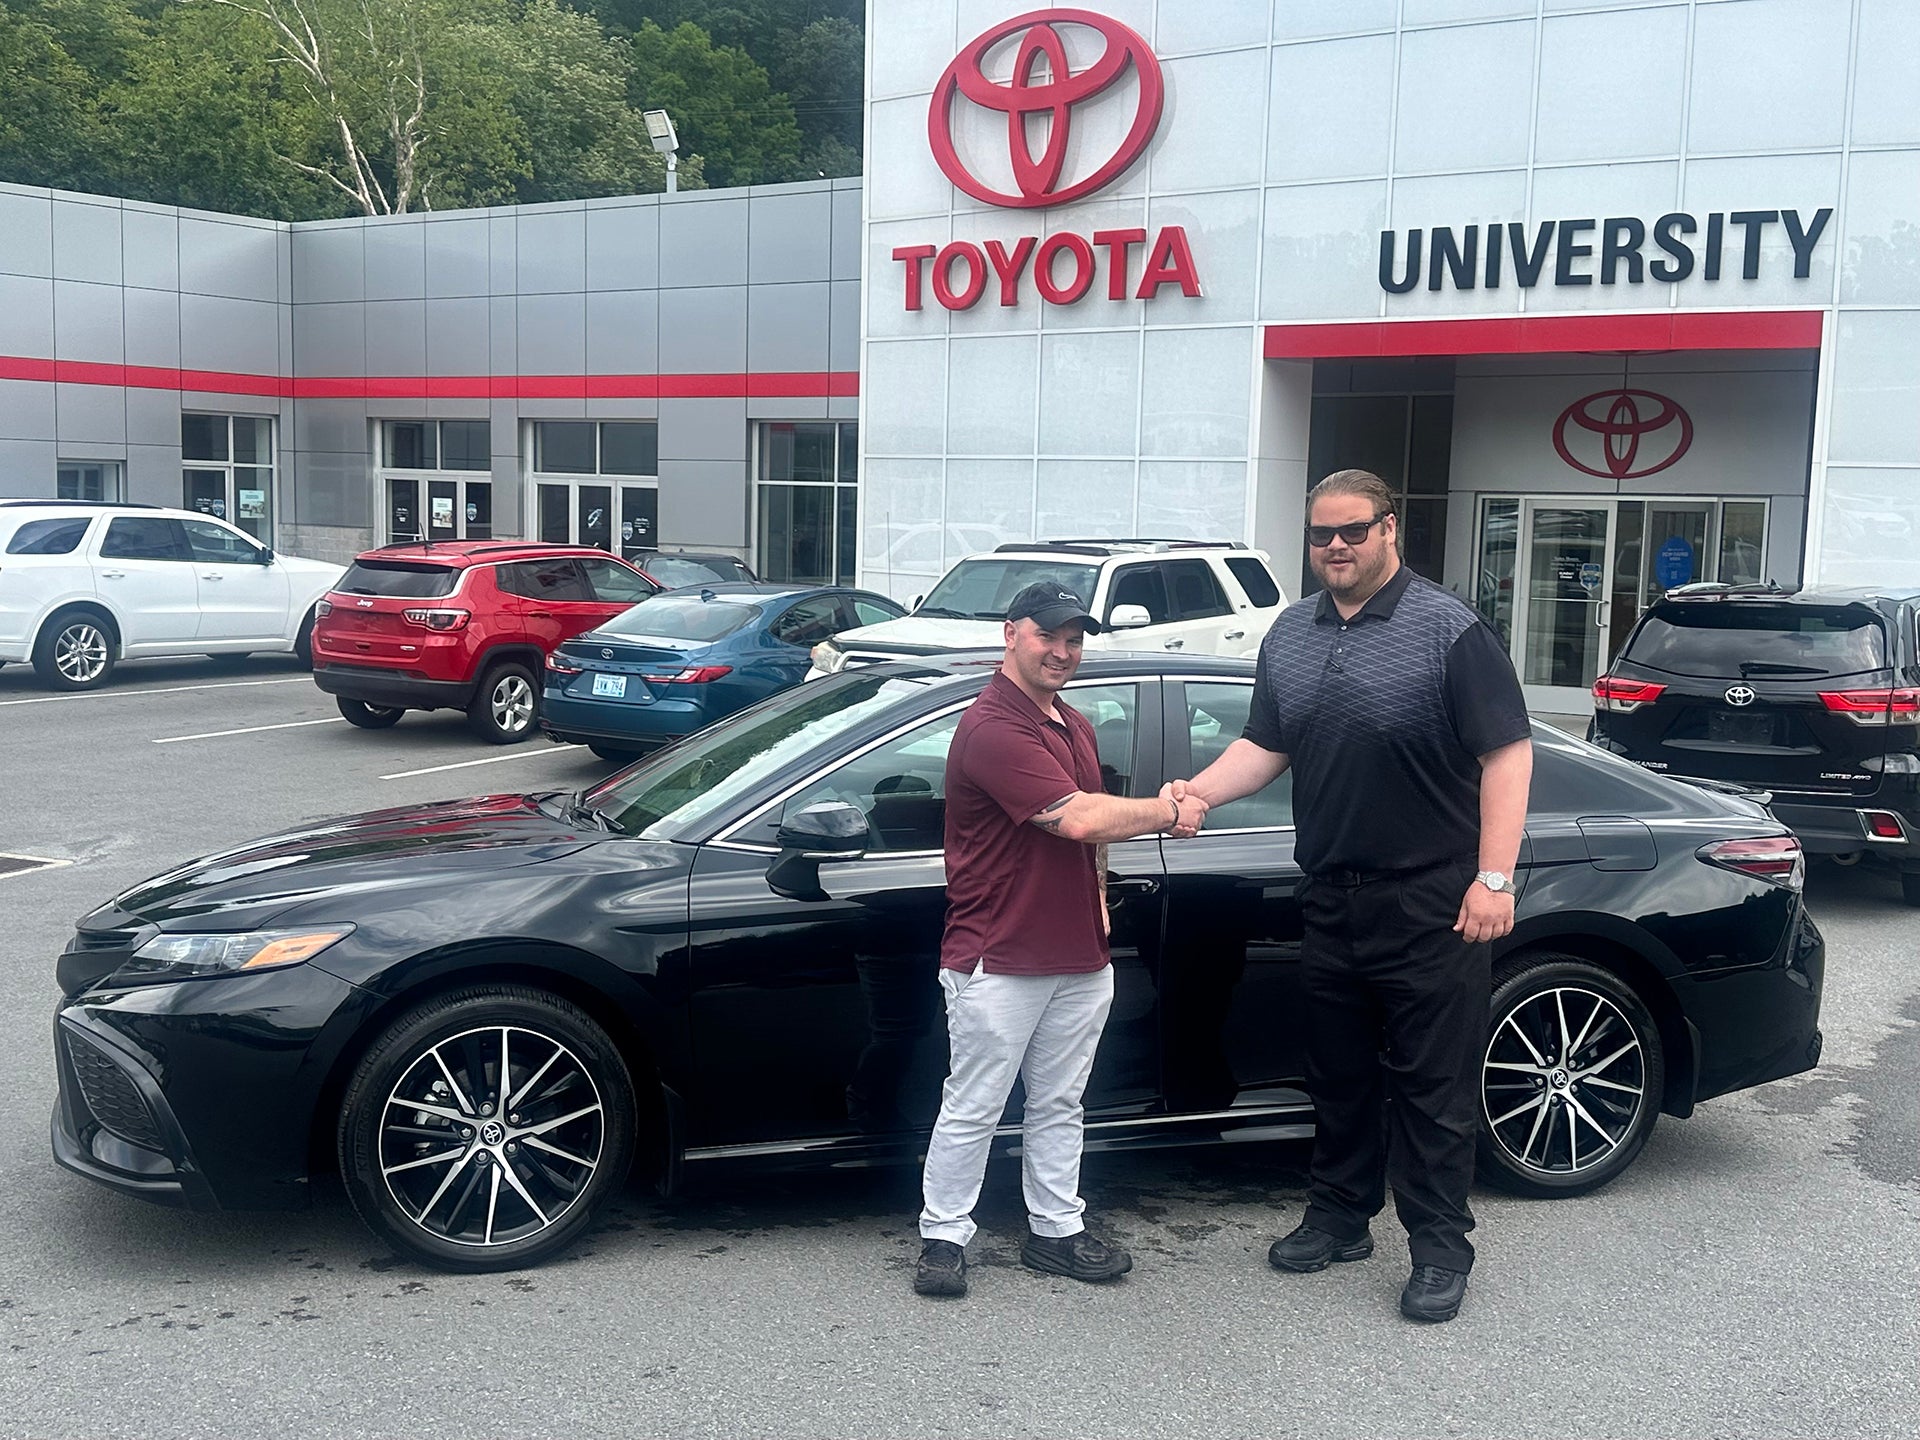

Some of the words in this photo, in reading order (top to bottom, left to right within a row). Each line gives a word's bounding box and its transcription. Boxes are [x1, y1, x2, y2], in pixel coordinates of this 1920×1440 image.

[892, 226, 1203, 311] TOYOTA
[1378, 208, 1834, 294] UNIVERSITY
[357, 599, 374, 608] Jeep
